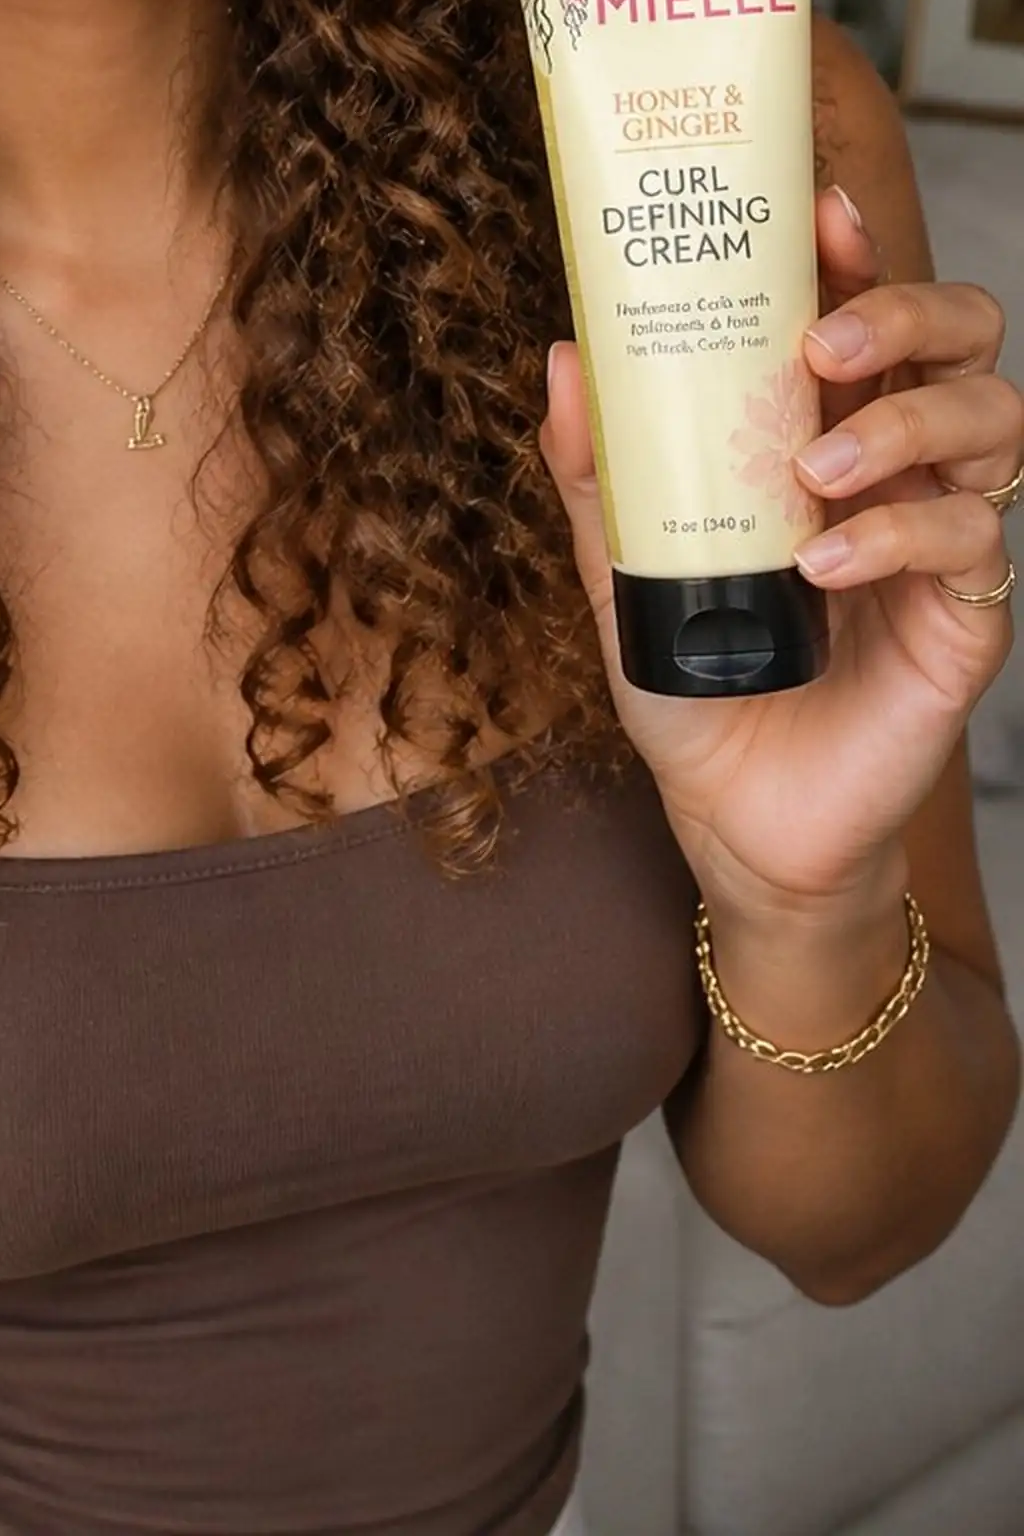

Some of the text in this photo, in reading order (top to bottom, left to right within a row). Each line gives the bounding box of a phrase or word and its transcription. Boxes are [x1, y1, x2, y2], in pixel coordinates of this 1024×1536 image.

[612, 83, 744, 115] HONEY &
[622, 111, 743, 142] GINGER
[638, 165, 729, 198] CURL
[602, 195, 771, 235] DEFINING
[623, 229, 752, 268] CREAM
[662, 519, 678, 534] 12
